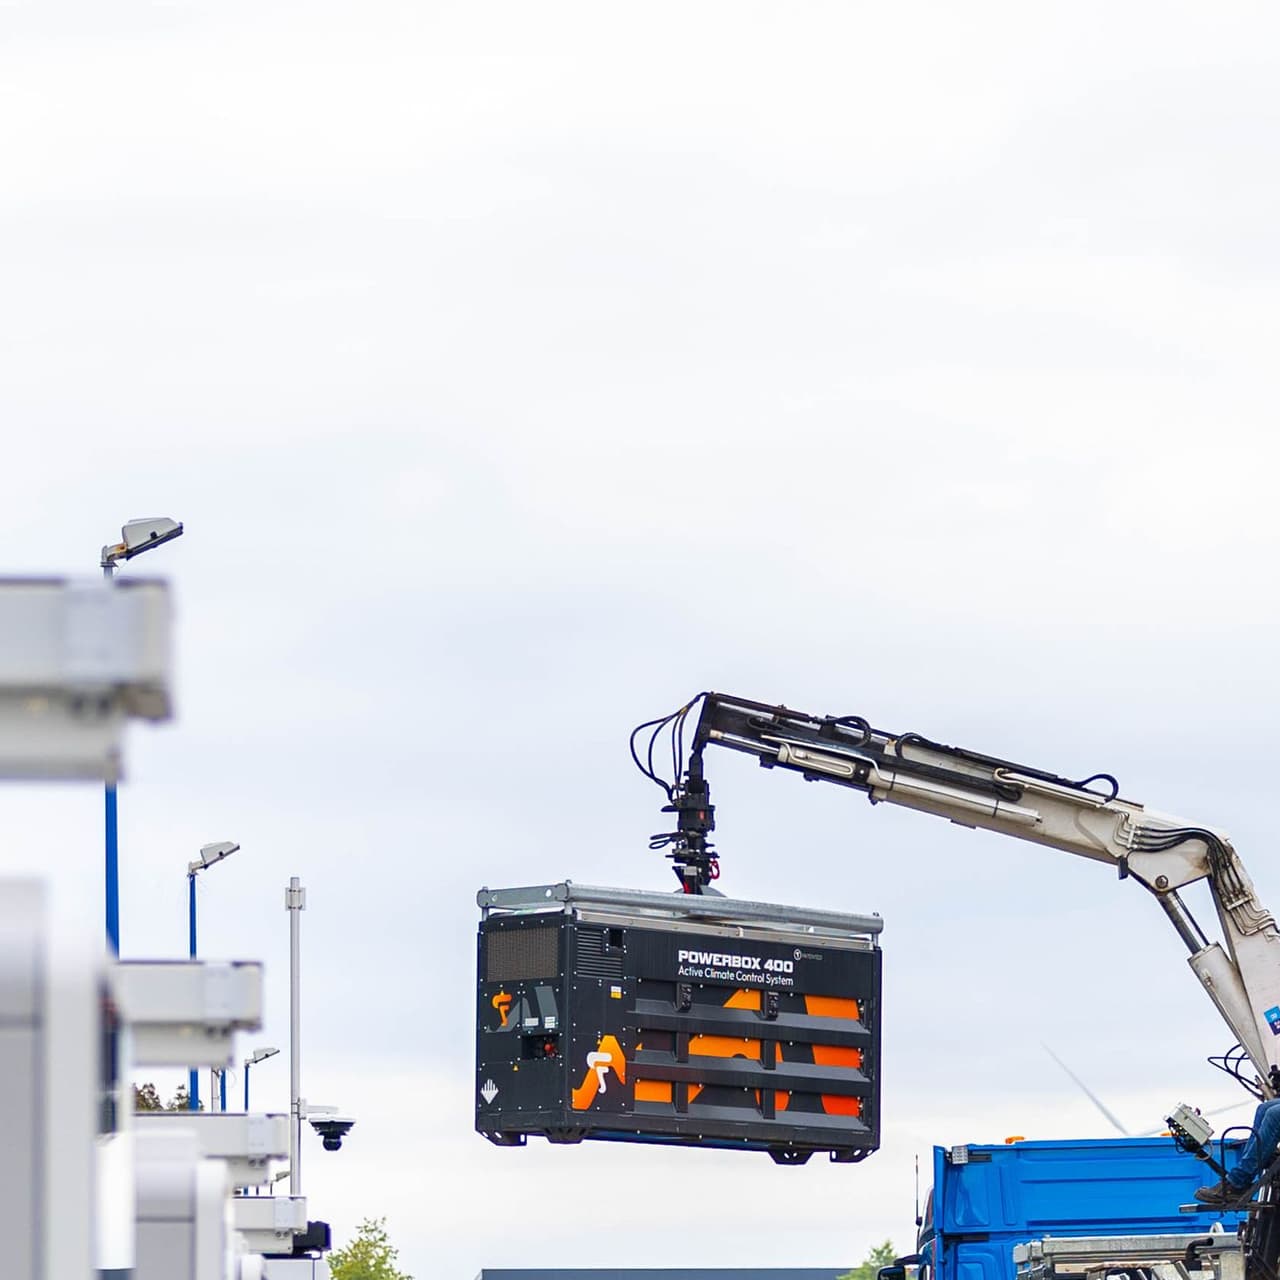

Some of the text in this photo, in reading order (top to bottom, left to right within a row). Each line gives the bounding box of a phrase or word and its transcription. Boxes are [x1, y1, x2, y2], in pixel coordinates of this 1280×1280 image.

[678, 950, 793, 973] POWERBOX 400
[678, 965, 793, 986] Active Climate Control System
